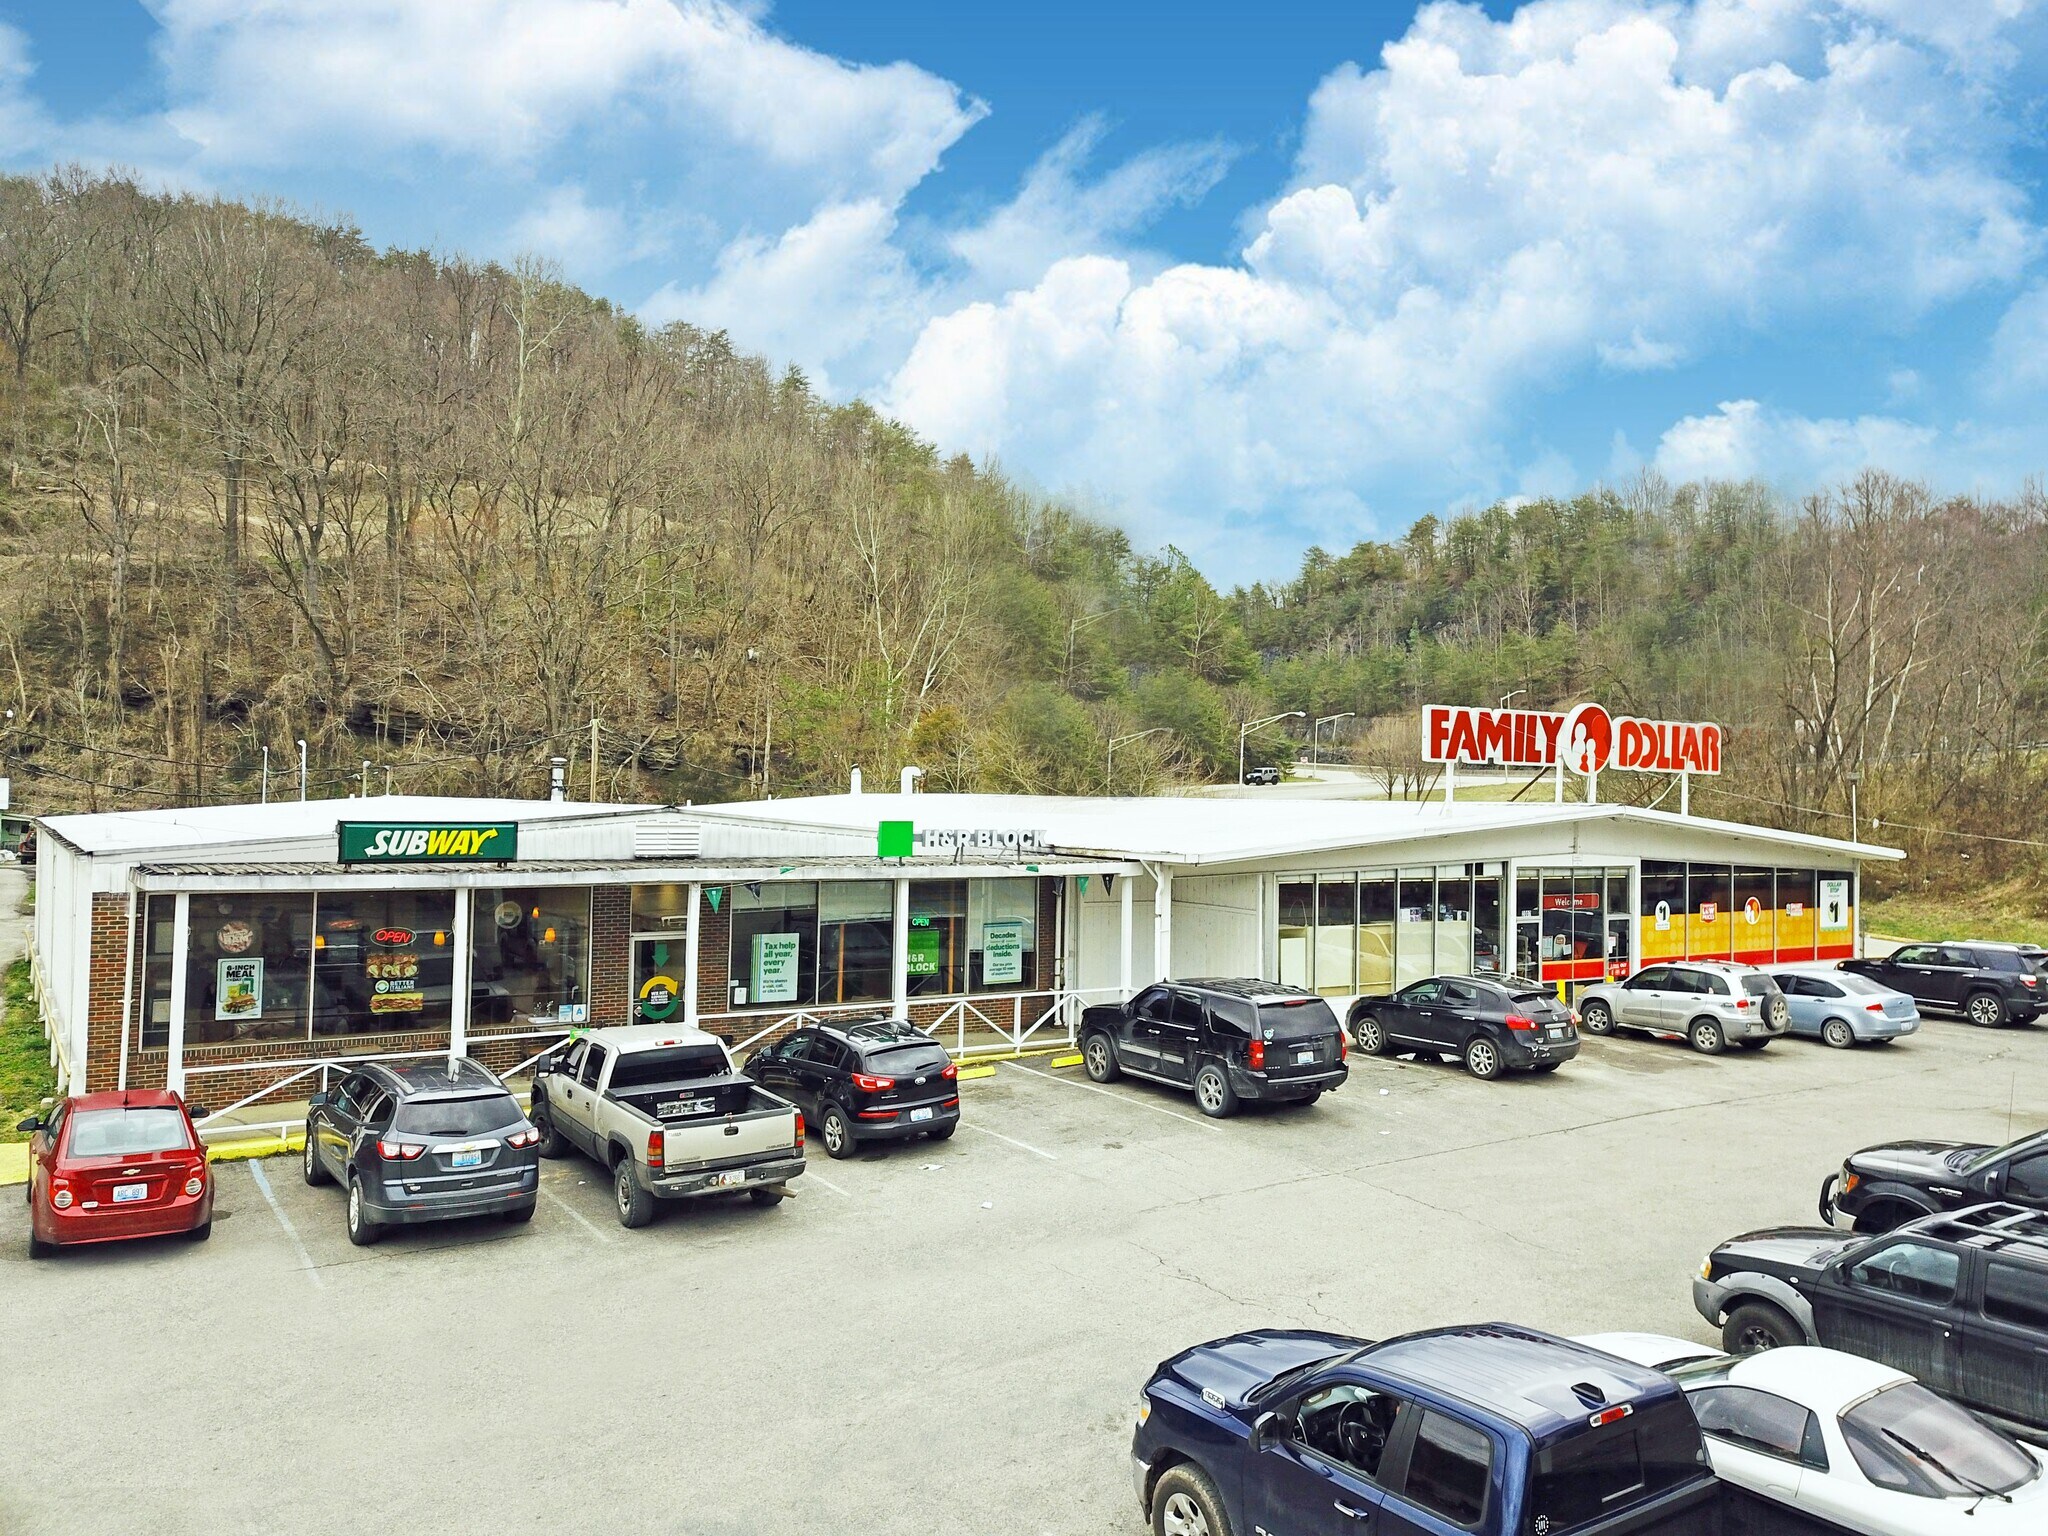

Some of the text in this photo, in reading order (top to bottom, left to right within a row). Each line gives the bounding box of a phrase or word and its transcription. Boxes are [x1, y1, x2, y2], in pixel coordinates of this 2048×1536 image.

[1430, 708, 1720, 772] FAMILY DOLLAR
[364, 828, 498, 857] SUBWAY
[922, 829, 1048, 848] H&R BLOCK
[1554, 897, 1583, 906] Welcme
[1829, 901, 1839, 923] $1
[911, 918, 930, 927] OPEN
[376, 929, 411, 943] OPEN
[779, 941, 796, 950] help
[763, 959, 785, 967] every
[226, 970, 255, 978] MEAL
[575, 1007, 583, 1015] A
